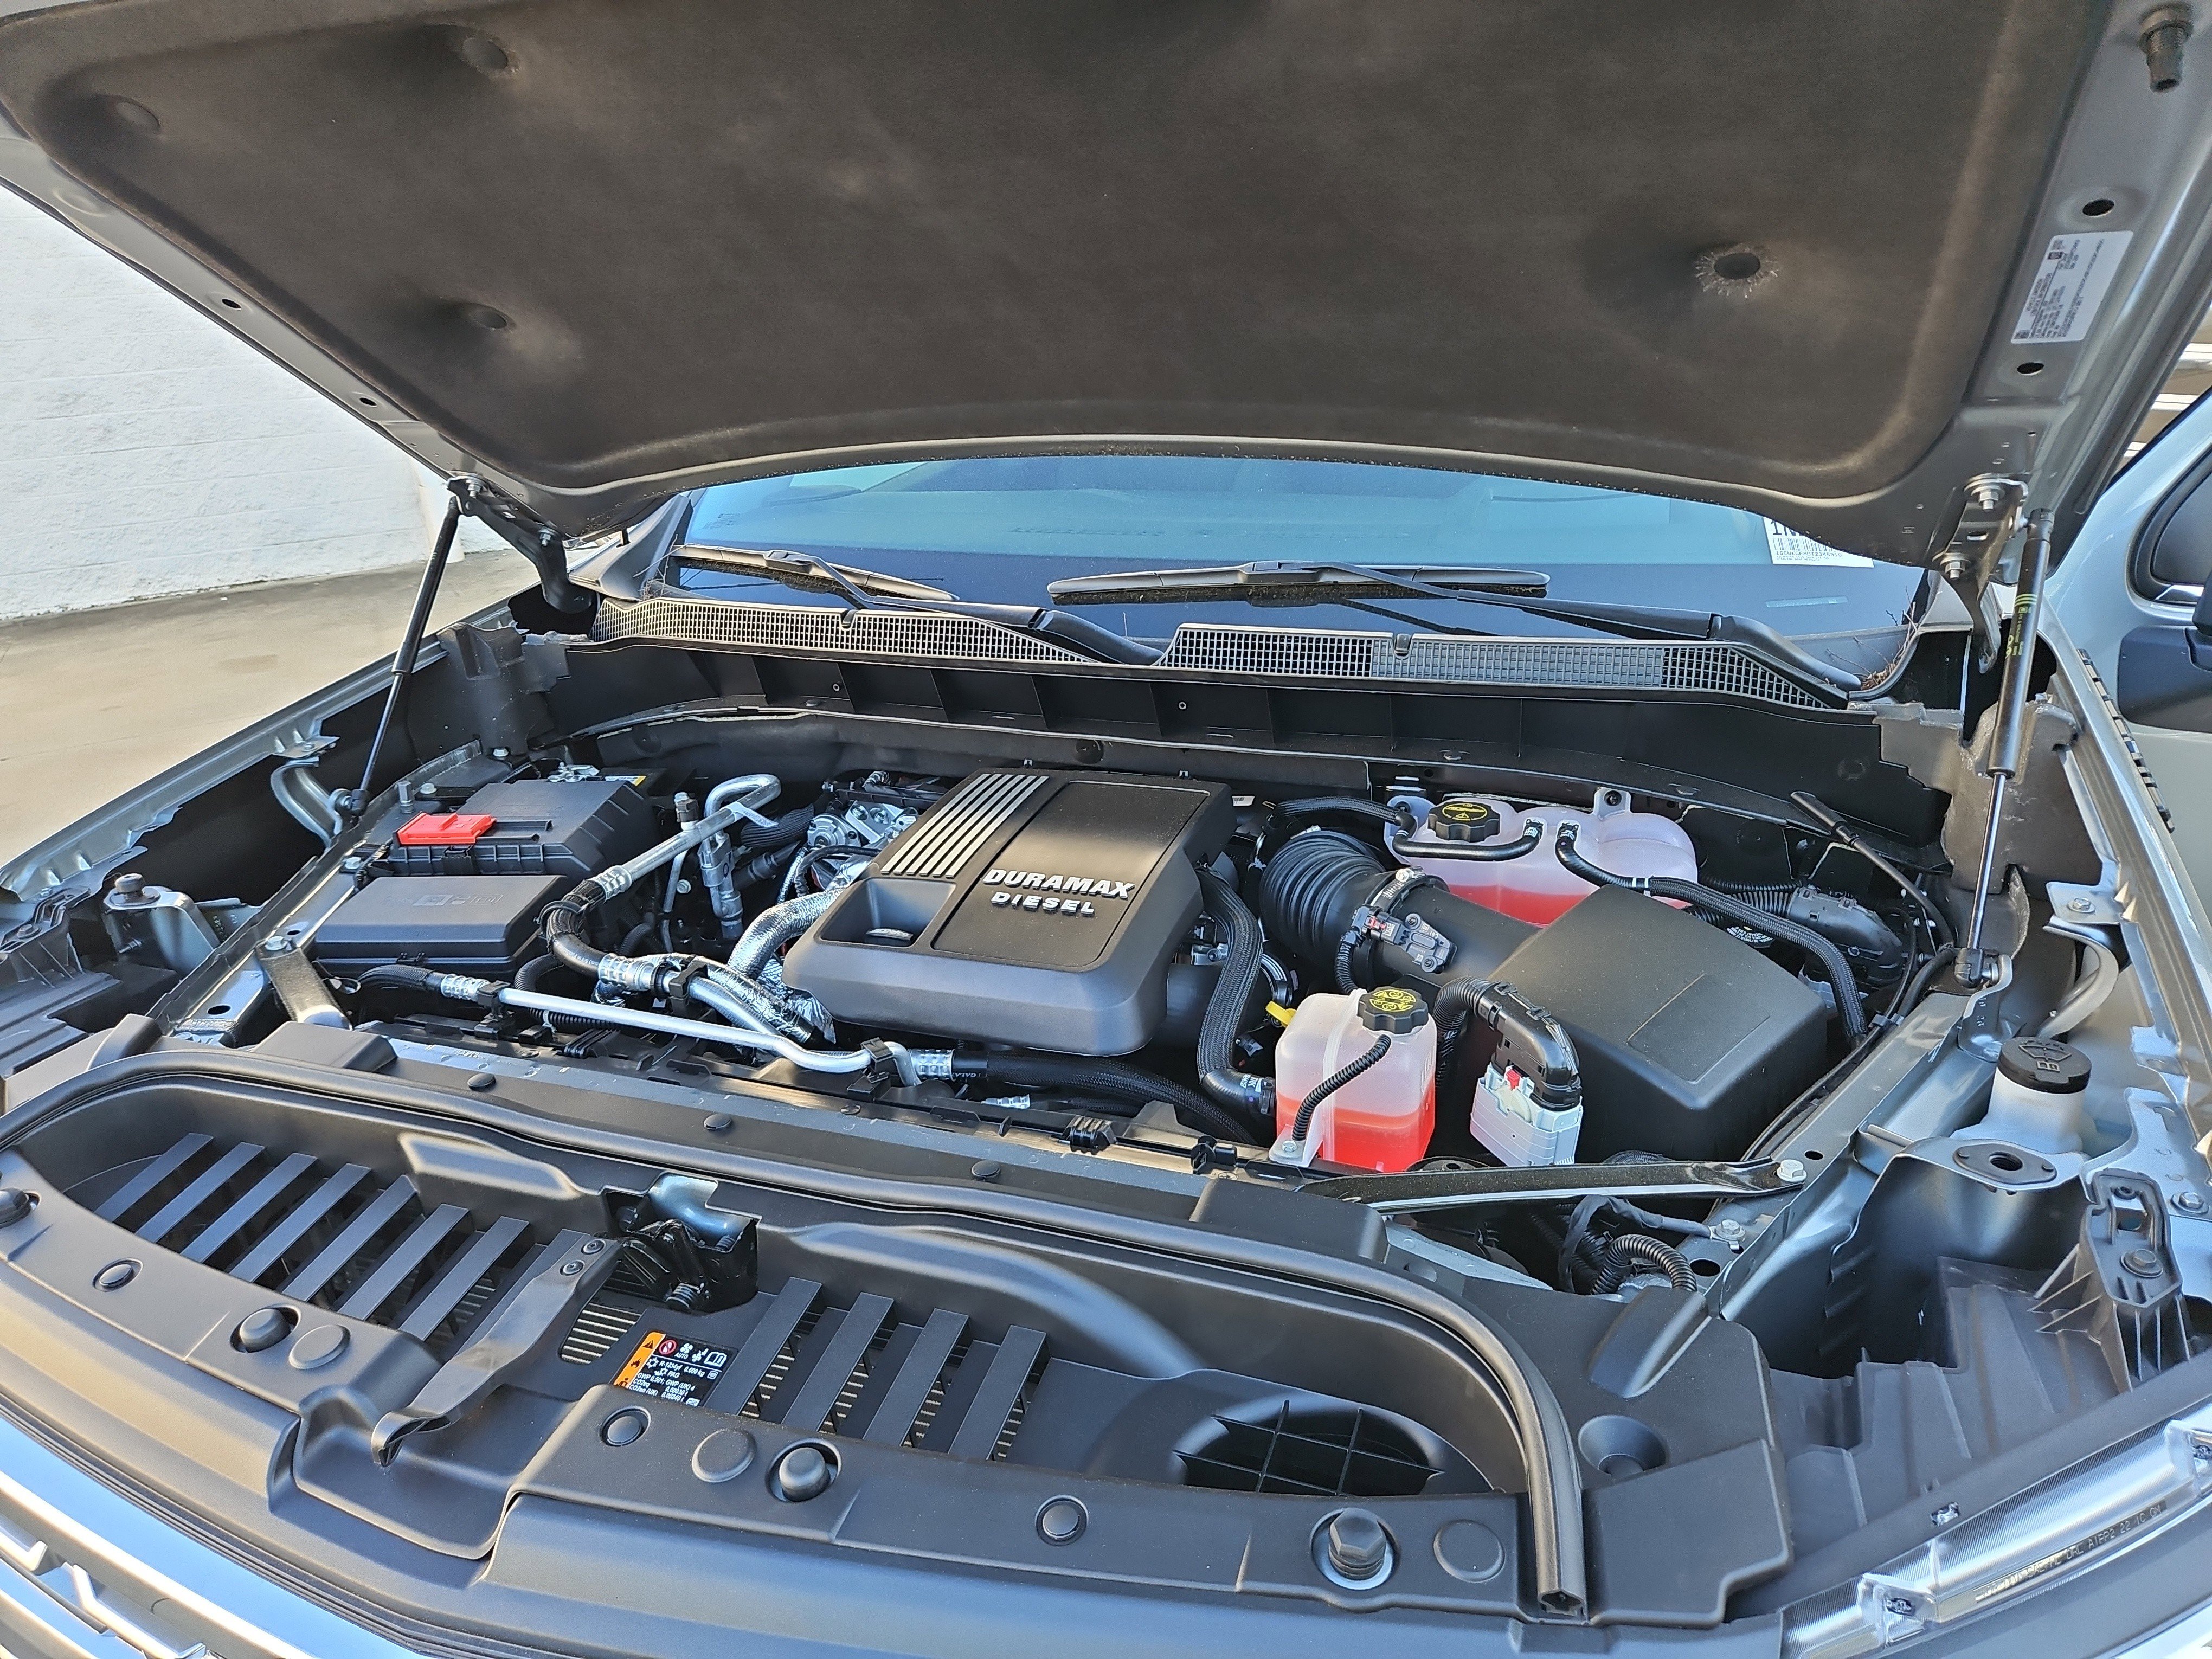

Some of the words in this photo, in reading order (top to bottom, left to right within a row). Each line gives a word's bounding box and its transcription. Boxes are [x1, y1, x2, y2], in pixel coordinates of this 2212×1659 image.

[982, 869, 1135, 899] DURAMAX
[991, 892, 1095, 915] DIESEL
[637, 1372, 651, 1380] GWP
[665, 1379, 679, 1387] GWP
[678, 1382, 691, 1391] (UK)
[667, 1371, 680, 1379] PAG
[2119, 1520, 2131, 1534] 22
